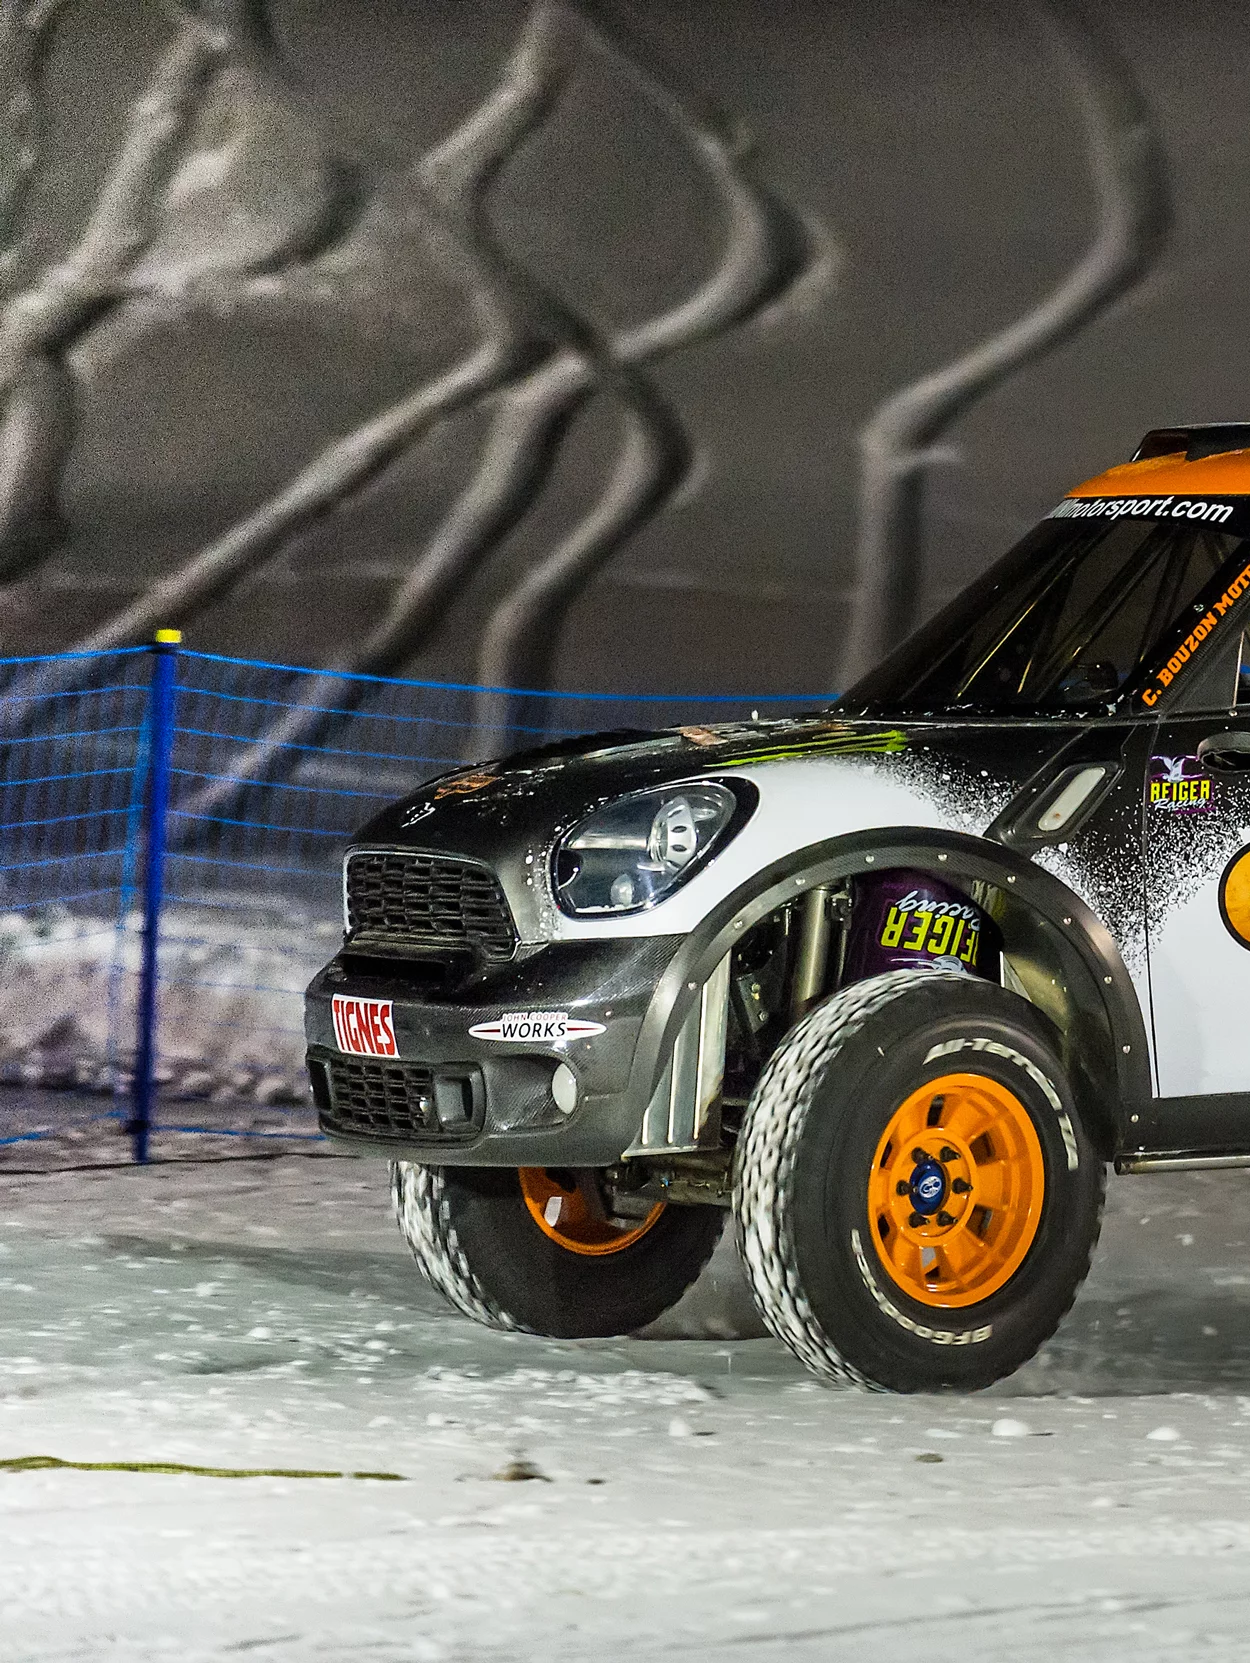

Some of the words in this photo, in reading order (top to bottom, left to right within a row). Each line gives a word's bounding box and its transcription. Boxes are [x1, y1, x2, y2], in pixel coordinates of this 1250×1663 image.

[1142, 689, 1162, 707] C.
[1156, 612, 1218, 688] BOUZON
[880, 906, 980, 967] EIGER
[333, 1000, 396, 1056] TIGNES
[502, 1014, 527, 1022] JOHN
[530, 1013, 567, 1021] COOPER
[502, 1022, 566, 1038] WORKS
